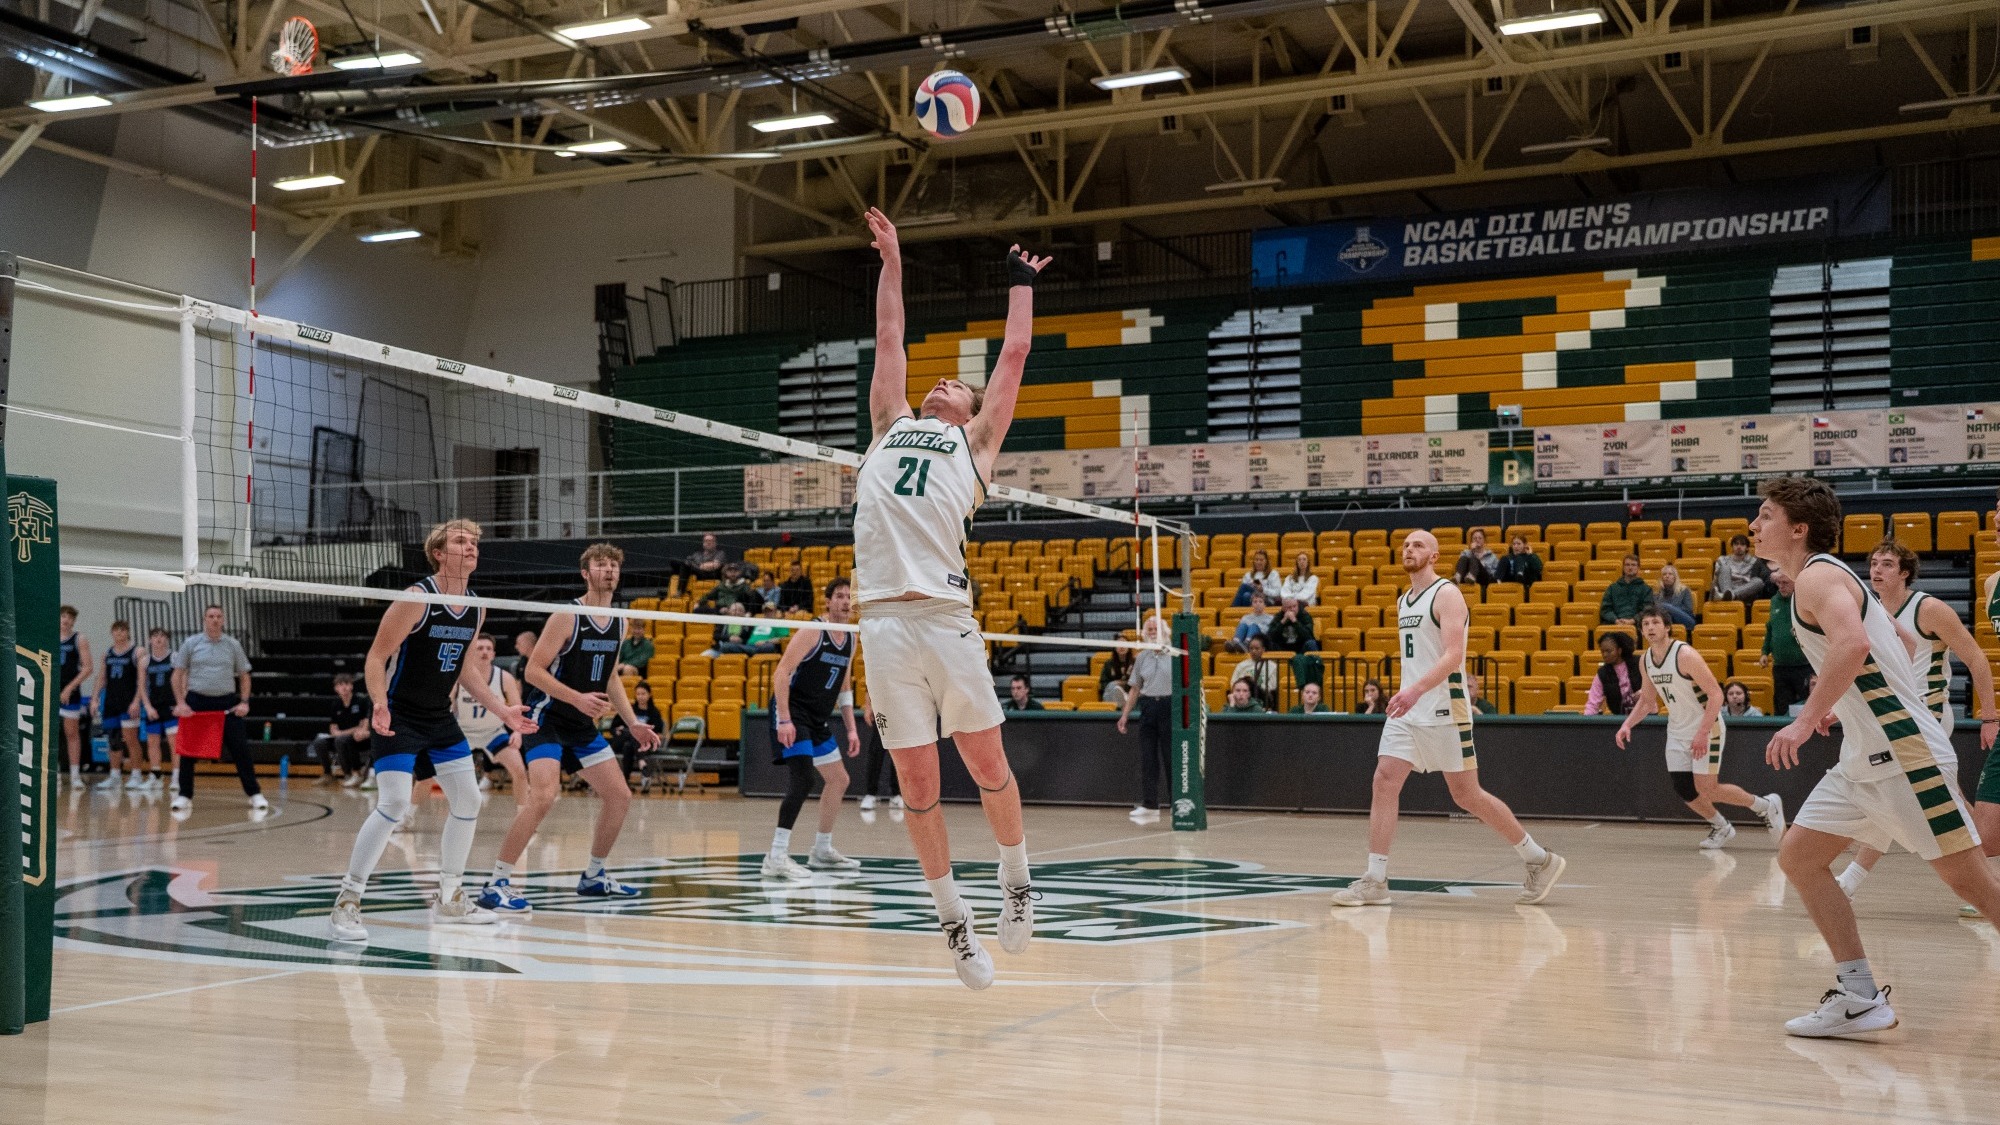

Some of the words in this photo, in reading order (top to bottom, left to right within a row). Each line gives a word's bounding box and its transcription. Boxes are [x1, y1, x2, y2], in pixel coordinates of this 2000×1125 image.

[1487, 212, 1535, 236] DII
[1542, 203, 1631, 232] MEN'S
[1404, 232, 1575, 267] BASKETBALL
[1584, 207, 1828, 250] CHAMPIONSHIP
[298, 325, 332, 342] MINERS
[438, 360, 464, 373] MINERS
[554, 387, 578, 399] MINERS
[1741, 434, 1768, 444] MARK
[1814, 429, 1858, 440] RODRIGO
[1603, 441, 1628, 451] ZYON
[1671, 437, 1699, 447] KHIBA
[1367, 451, 1418, 461] ALEXANDER
[1428, 449, 1465, 459] JULIANO
[1537, 445, 1559, 454] LIAM
[1307, 455, 1326, 464] LUIZ
[894, 456, 931, 497] 21
[1504, 460, 1519, 486] B
[1405, 633, 1414, 658] 6
[438, 642, 464, 672] 42
[591, 654, 605, 681] 11
[825, 666, 840, 689] 7
[1662, 686, 1676, 703] 14
[473, 705, 487, 718] 17
